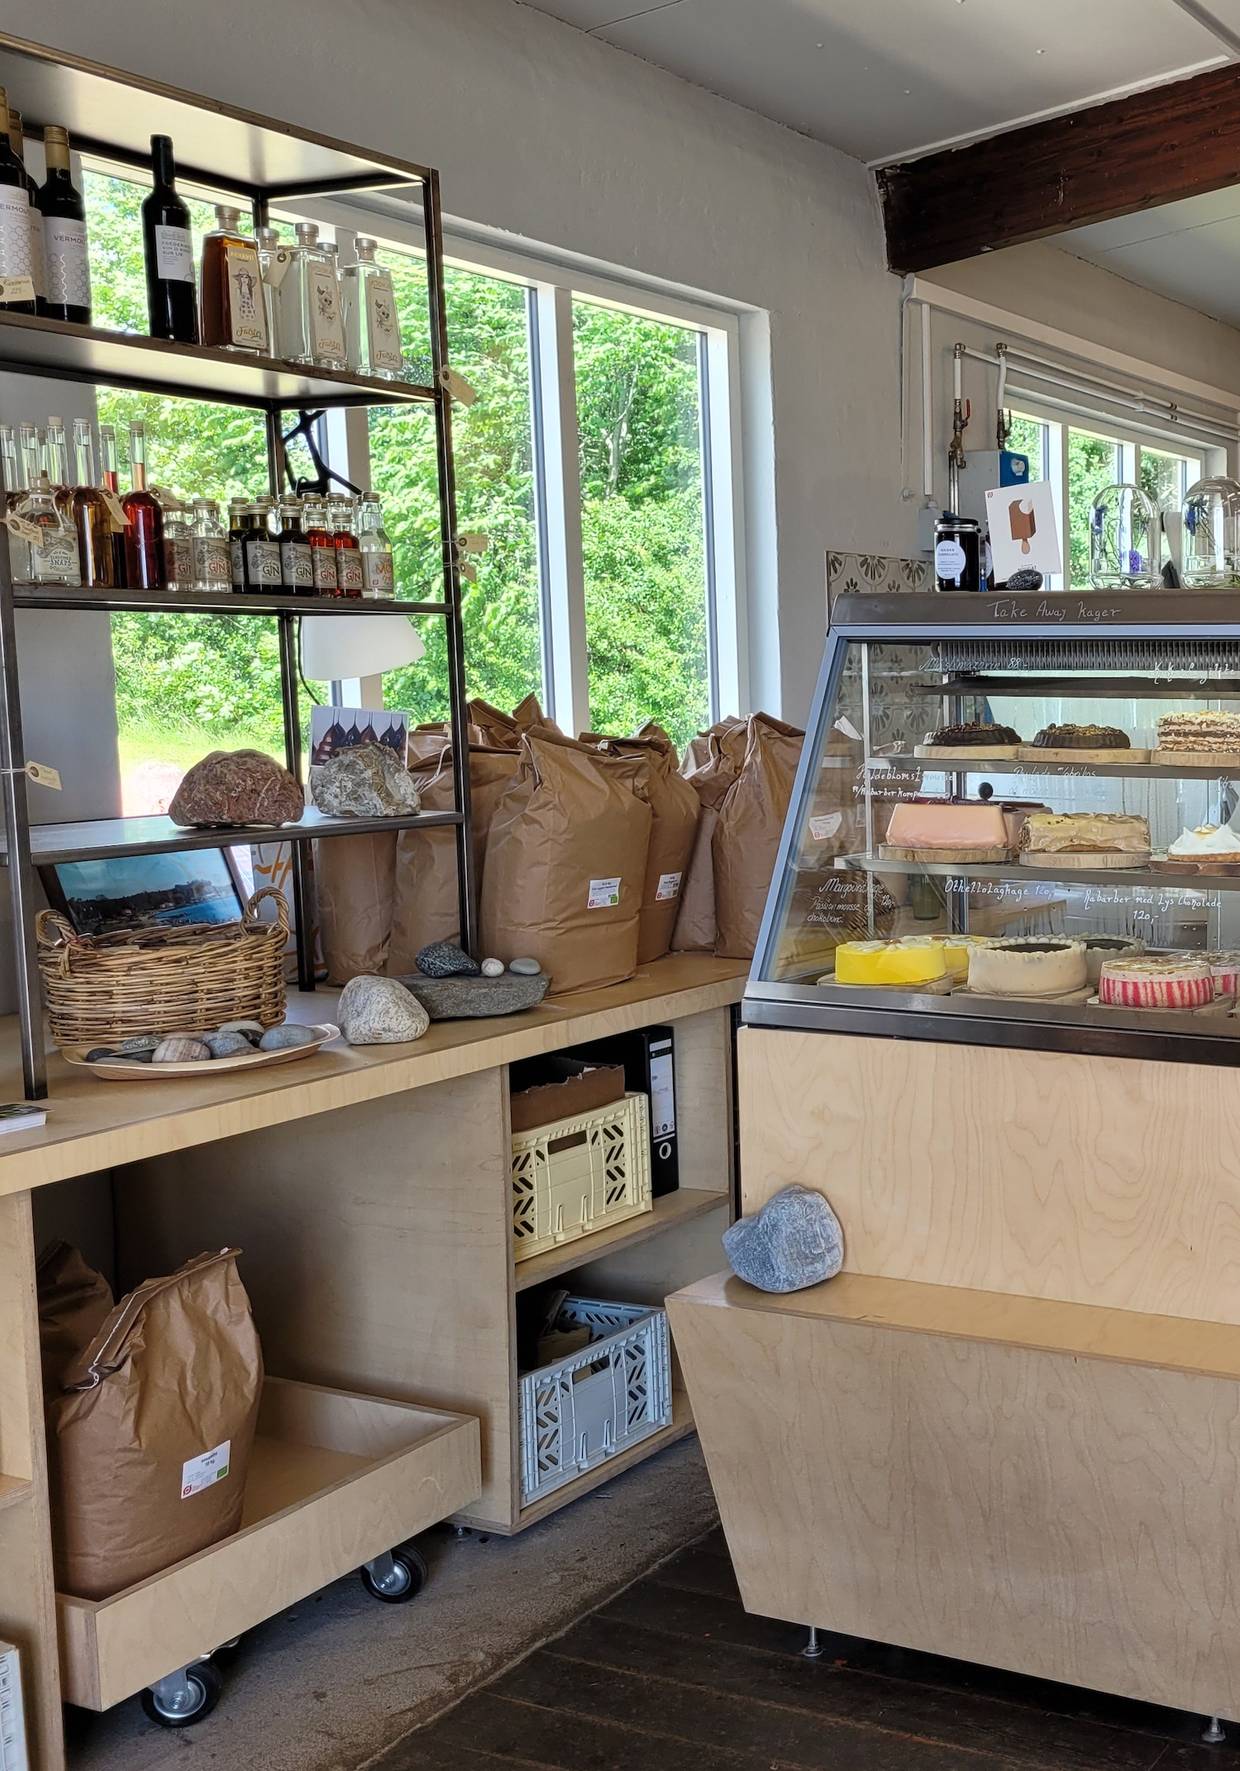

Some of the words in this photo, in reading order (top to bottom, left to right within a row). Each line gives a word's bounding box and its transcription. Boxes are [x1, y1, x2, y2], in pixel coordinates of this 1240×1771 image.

[262, 565, 280, 577] GIN
[296, 566, 312, 578] GIN
[320, 569, 336, 581] GIN
[345, 571, 361, 582] GIN
[986, 599, 1028, 618] Take
[1035, 599, 1066, 622] Away
[1135, 894, 1155, 904] med
[1132, 909, 1160, 924] 120,-
